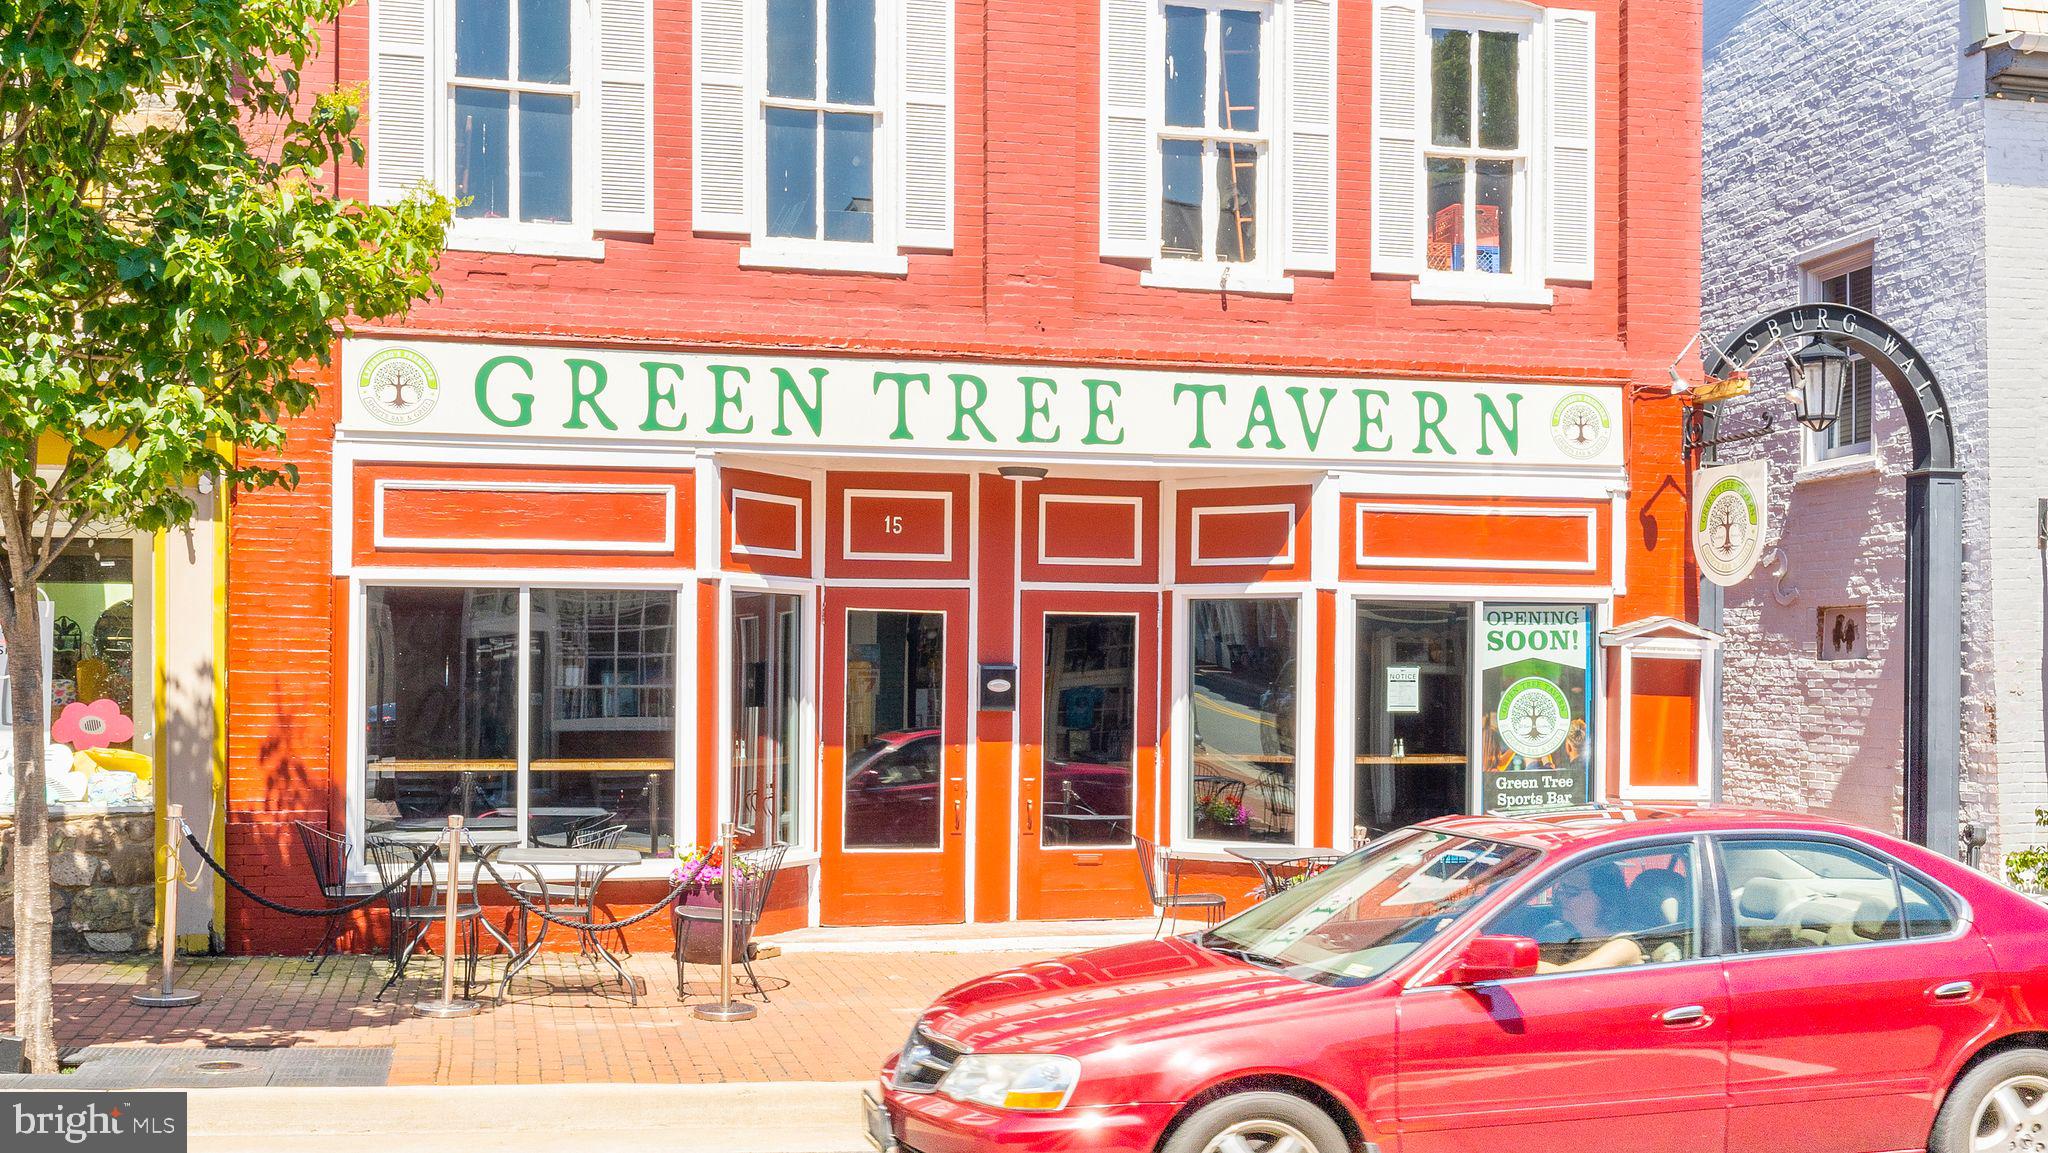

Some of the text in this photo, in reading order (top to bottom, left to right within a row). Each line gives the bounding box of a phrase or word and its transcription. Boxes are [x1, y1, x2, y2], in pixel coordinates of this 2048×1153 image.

[1702, 308, 1945, 425] LESBURG WALK
[475, 356, 829, 437] GREEN
[873, 373, 1123, 445] TREE
[1174, 384, 1524, 456] TAVERN
[884, 515, 903, 534] 15
[1486, 610, 1580, 625] OPENING
[1486, 629, 1580, 651] SOON!
[1496, 776, 1574, 789] Green Tree
[1497, 792, 1573, 809] Sports Bar
